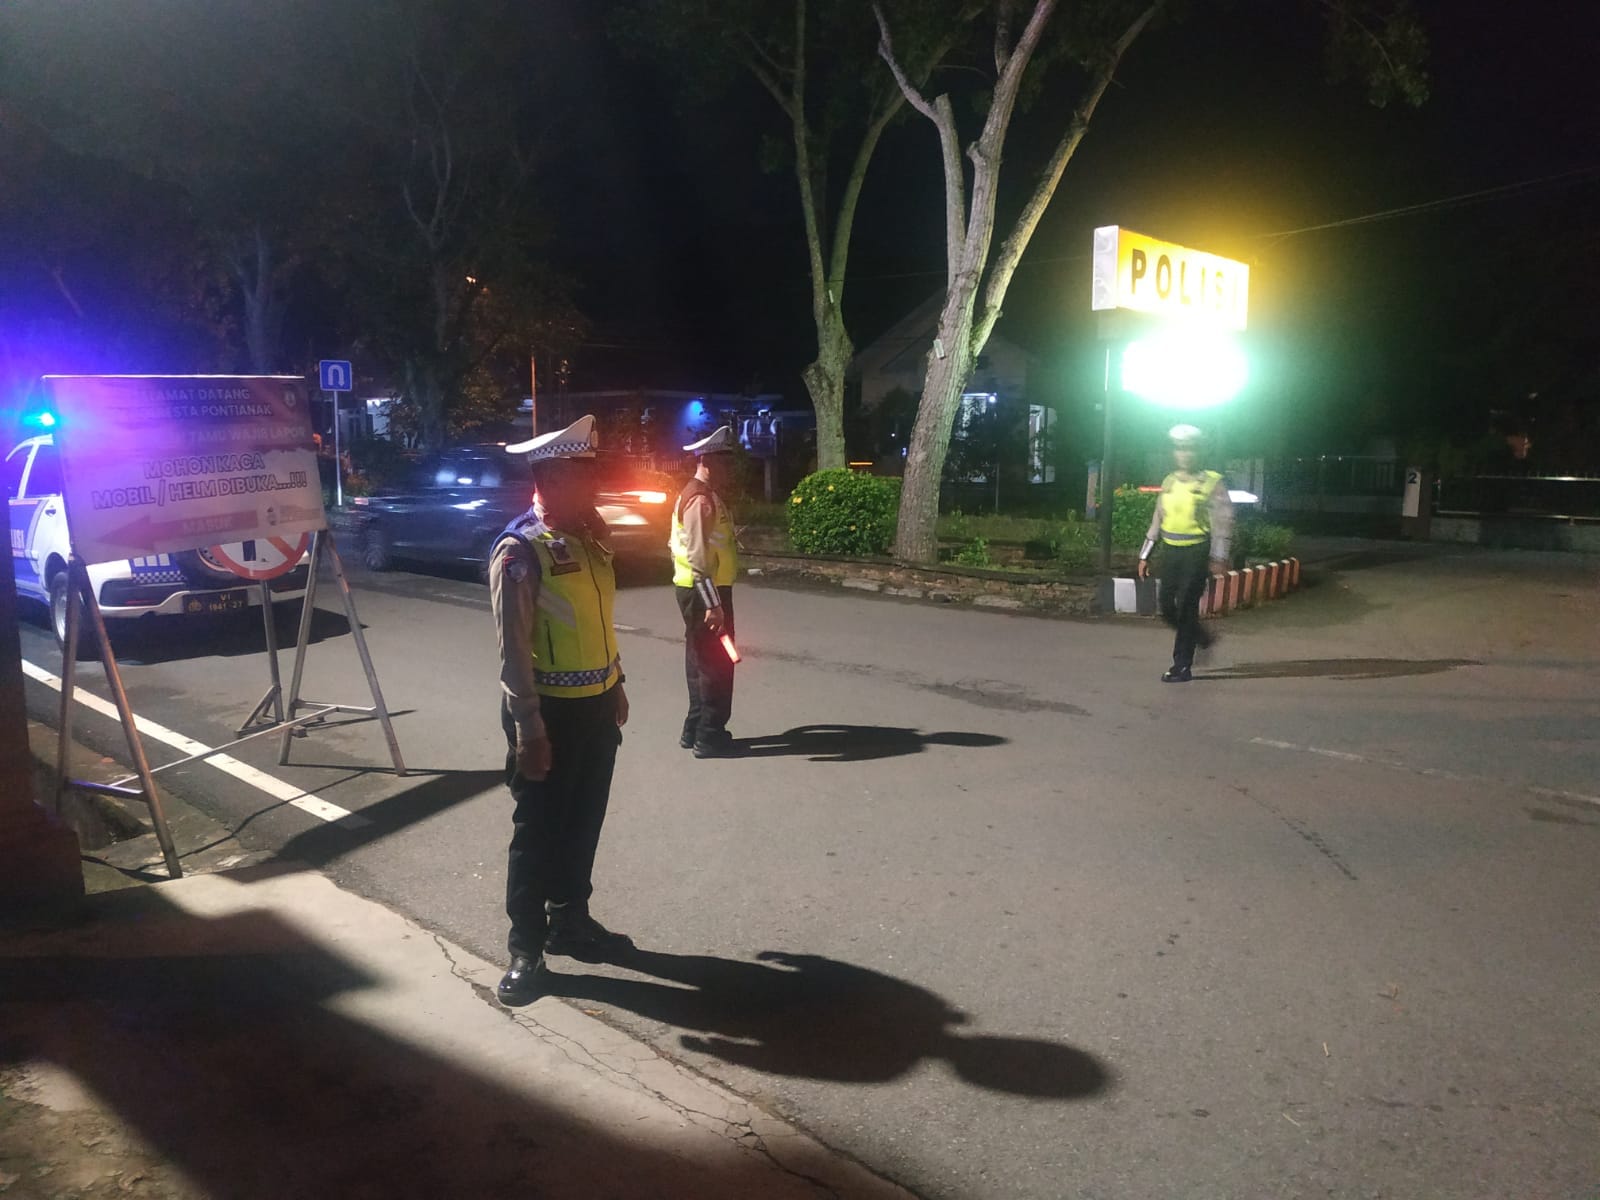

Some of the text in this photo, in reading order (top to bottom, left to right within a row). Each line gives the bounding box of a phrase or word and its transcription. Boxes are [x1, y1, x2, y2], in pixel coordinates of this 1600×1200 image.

[1130, 247, 1239, 313] POLISI
[200, 388, 250, 400] DATANG
[202, 404, 273, 417] PONTIANAK
[144, 452, 266, 480] MOHON KACA
[1408, 472, 1417, 484] 2
[91, 485, 156, 511] MOBIL
[168, 479, 220, 502] HELM
